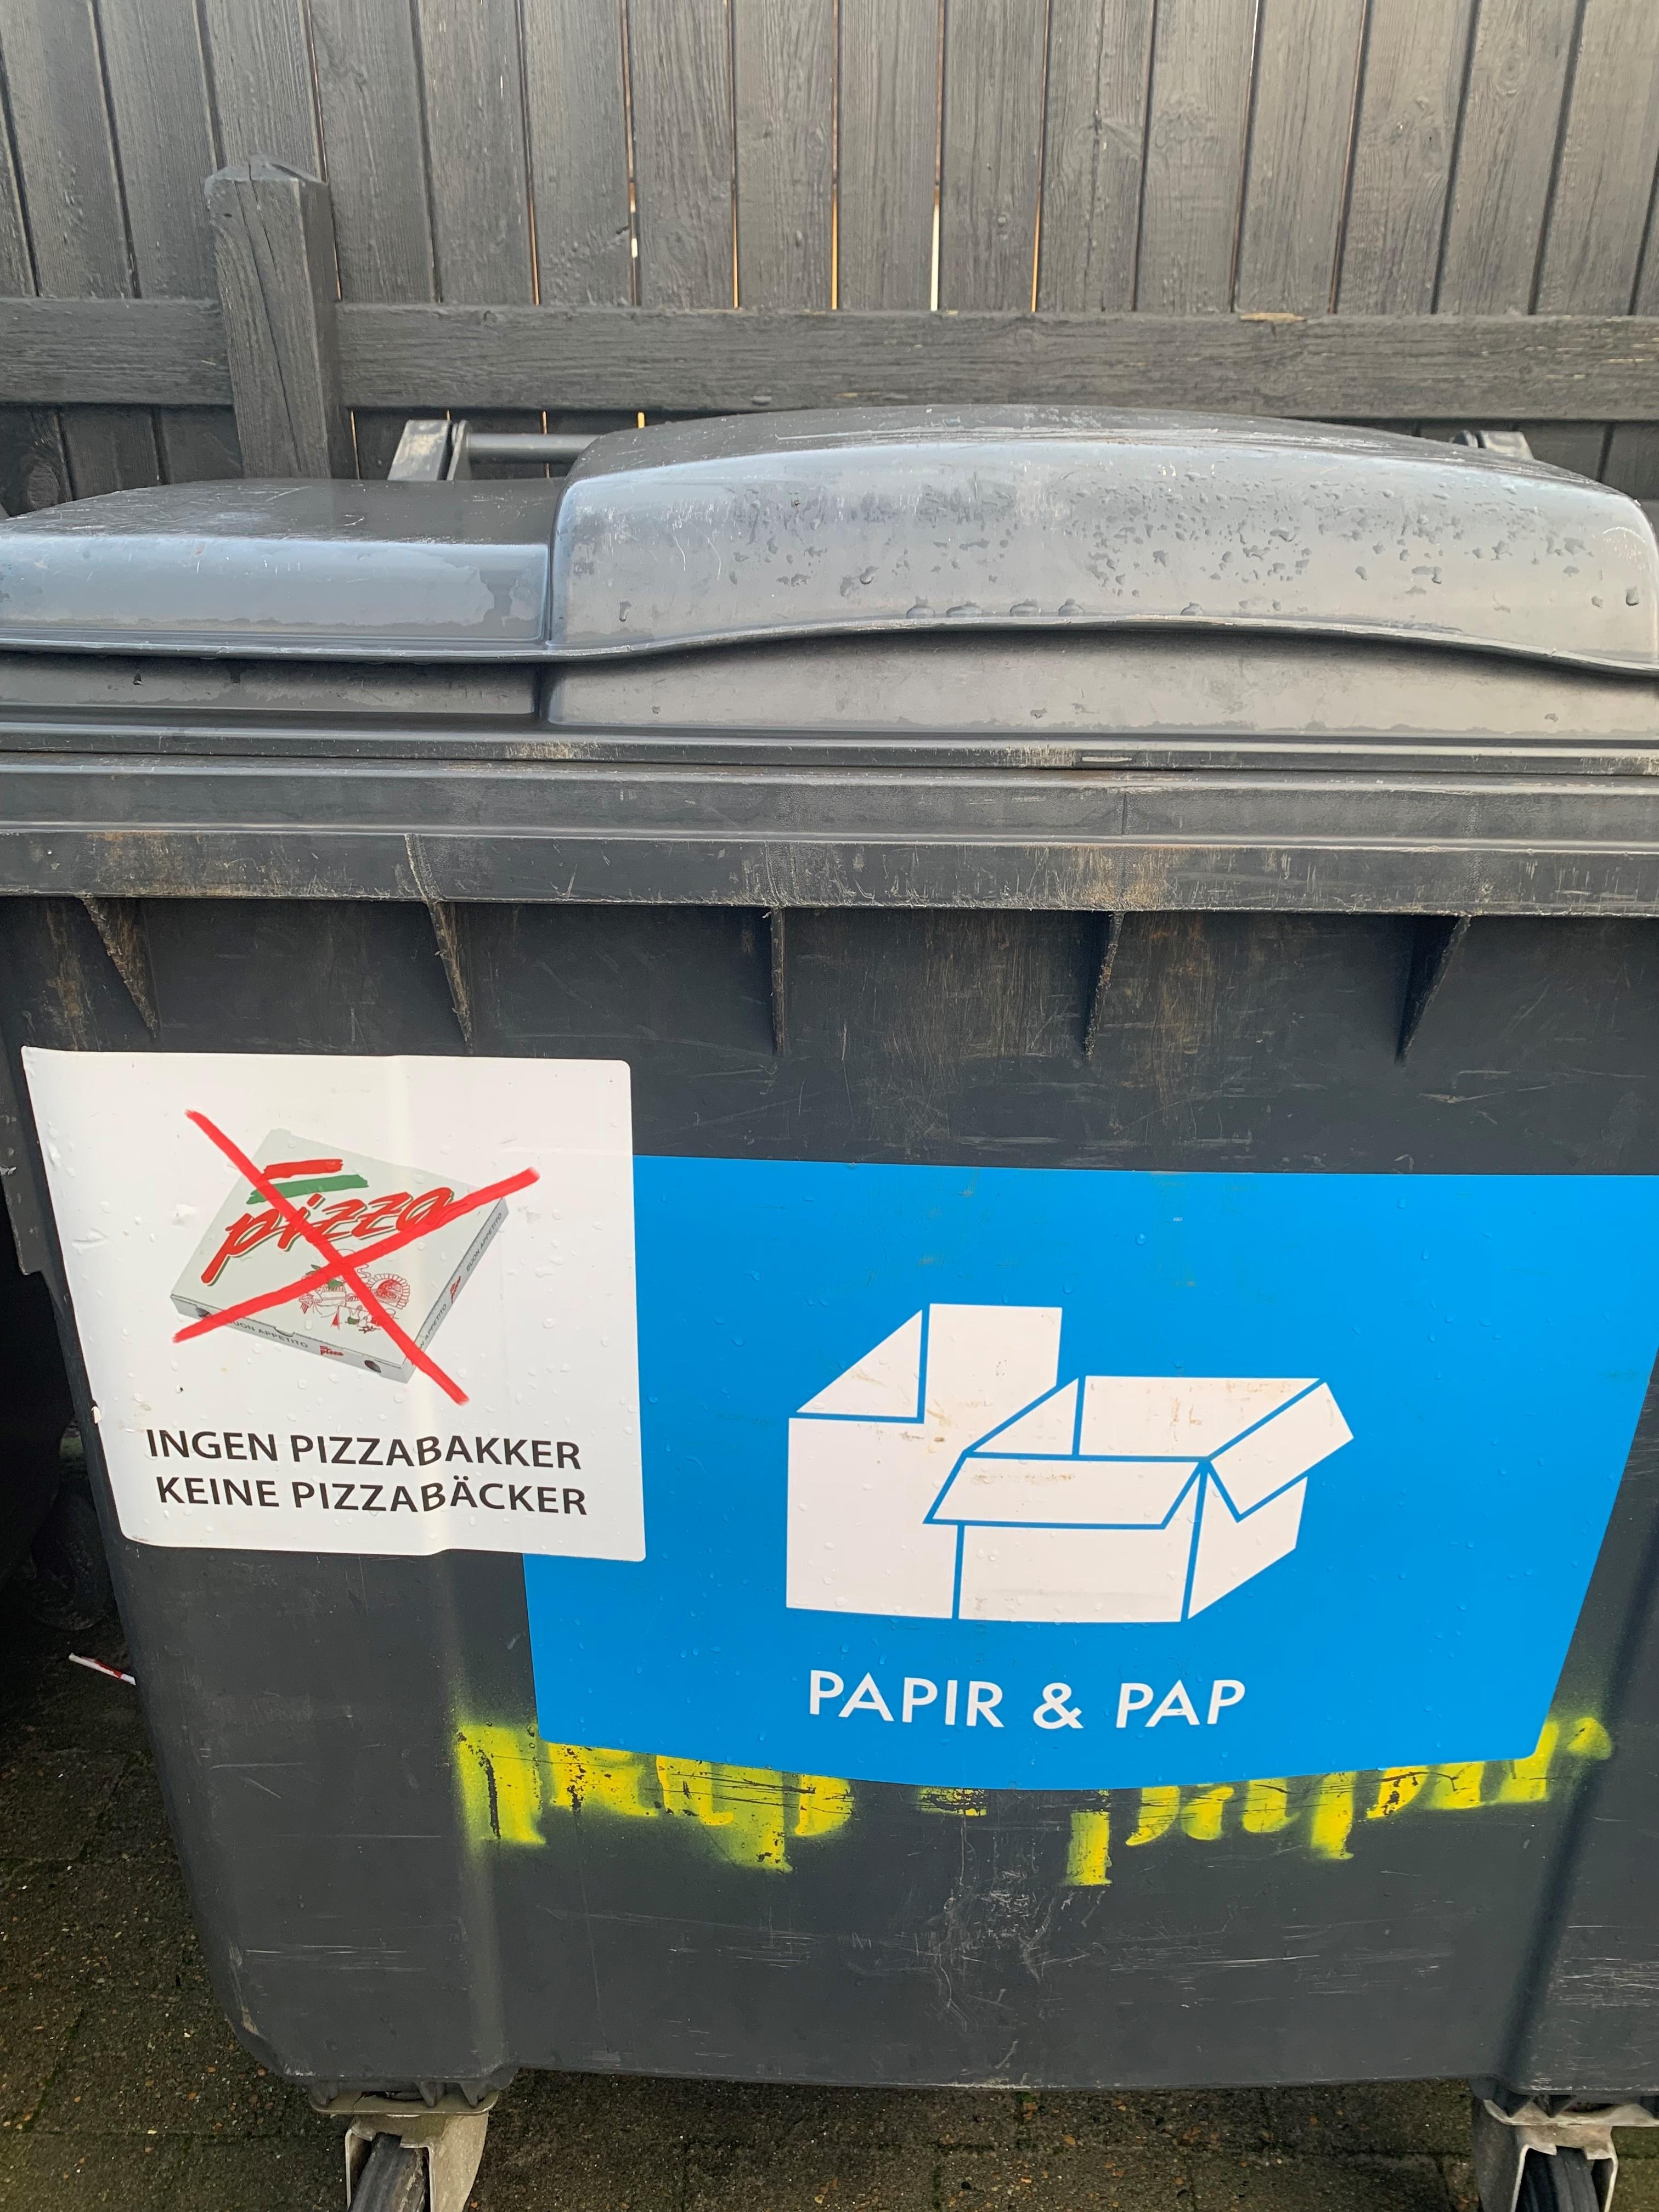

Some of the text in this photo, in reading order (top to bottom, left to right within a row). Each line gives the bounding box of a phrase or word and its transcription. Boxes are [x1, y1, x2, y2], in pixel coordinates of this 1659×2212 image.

[200, 1187, 457, 1286] pizza
[466, 1212, 502, 1272] BUON APPETITO
[225, 1318, 308, 1348] UON APPETITO
[146, 1429, 582, 1470] INGEN PIZZABAKKER
[156, 1475, 588, 1516] KEINE PIZZABÄCKER
[809, 1669, 1246, 1730] PAPIR & PAP
